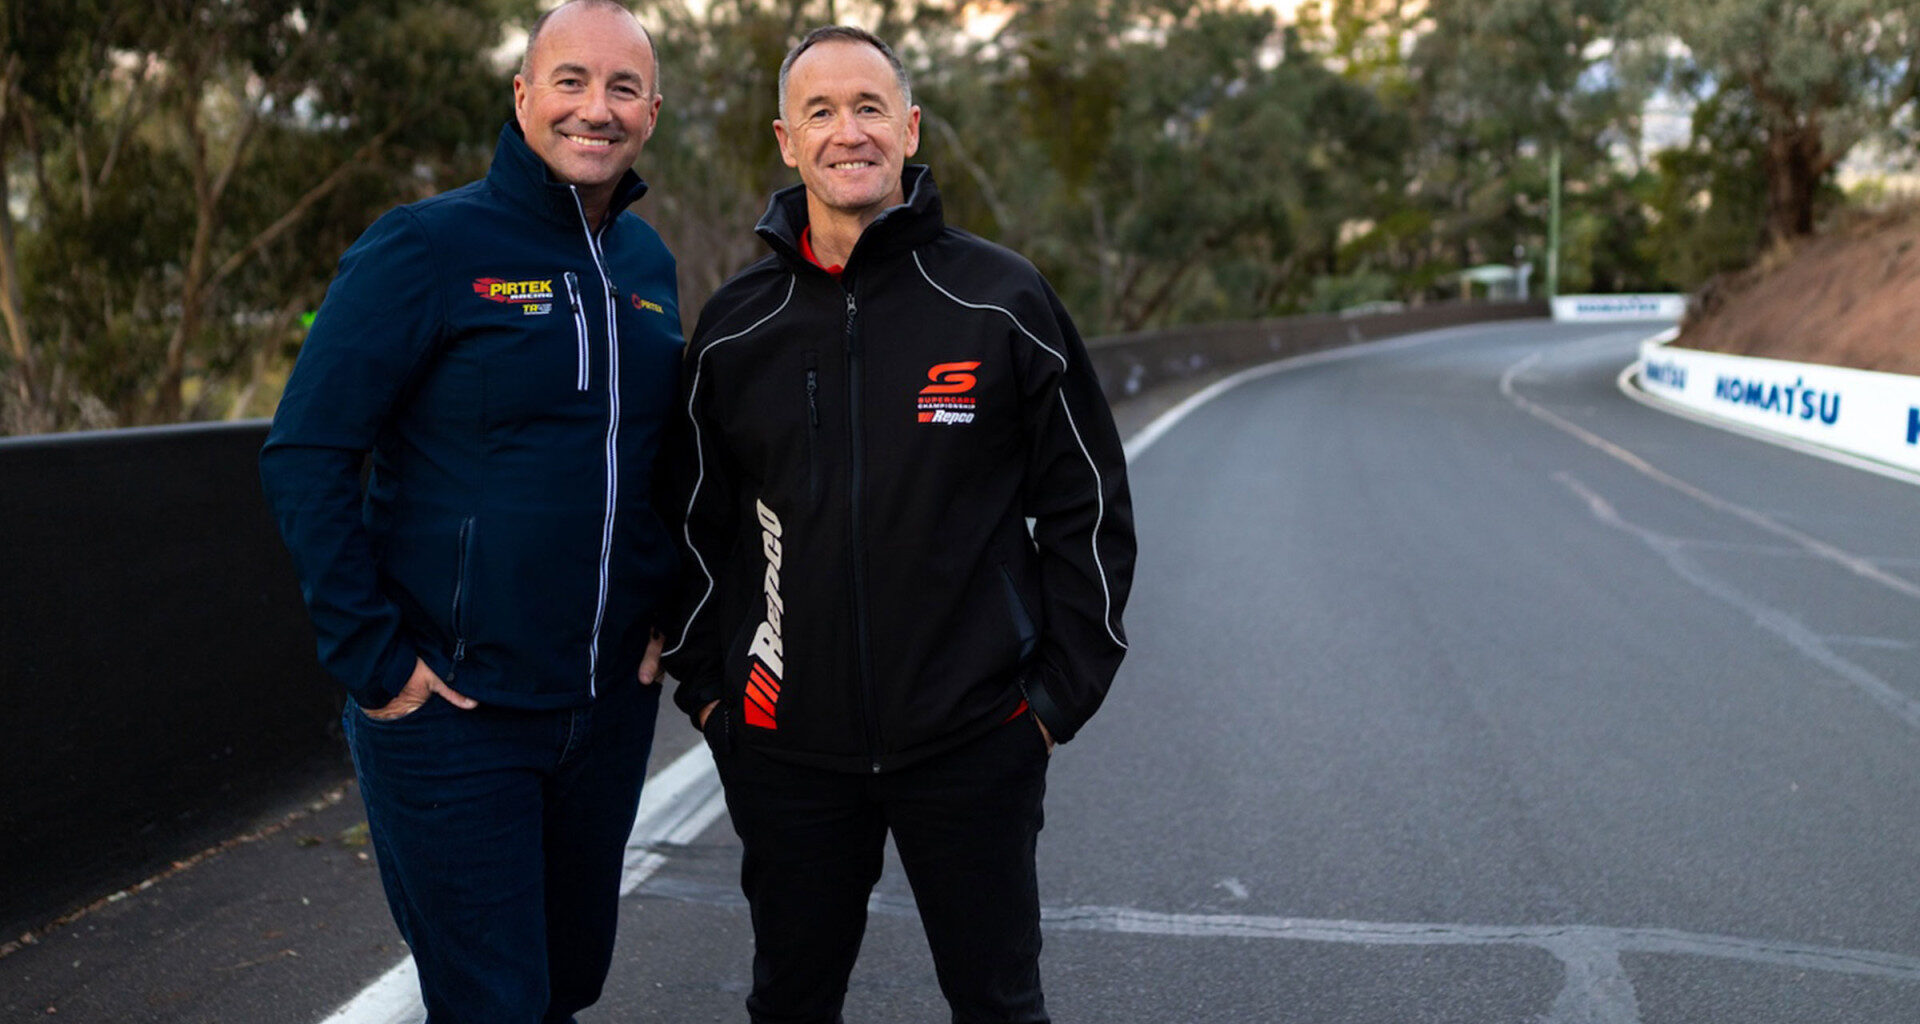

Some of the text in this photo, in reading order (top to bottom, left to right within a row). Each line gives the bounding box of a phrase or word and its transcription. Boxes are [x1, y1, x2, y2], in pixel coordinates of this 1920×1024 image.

[490, 280, 552, 297] PIRTEK
[931, 409, 975, 425] Repco
[1716, 376, 1840, 425] KOMATSU
[748, 498, 784, 680] Repco
